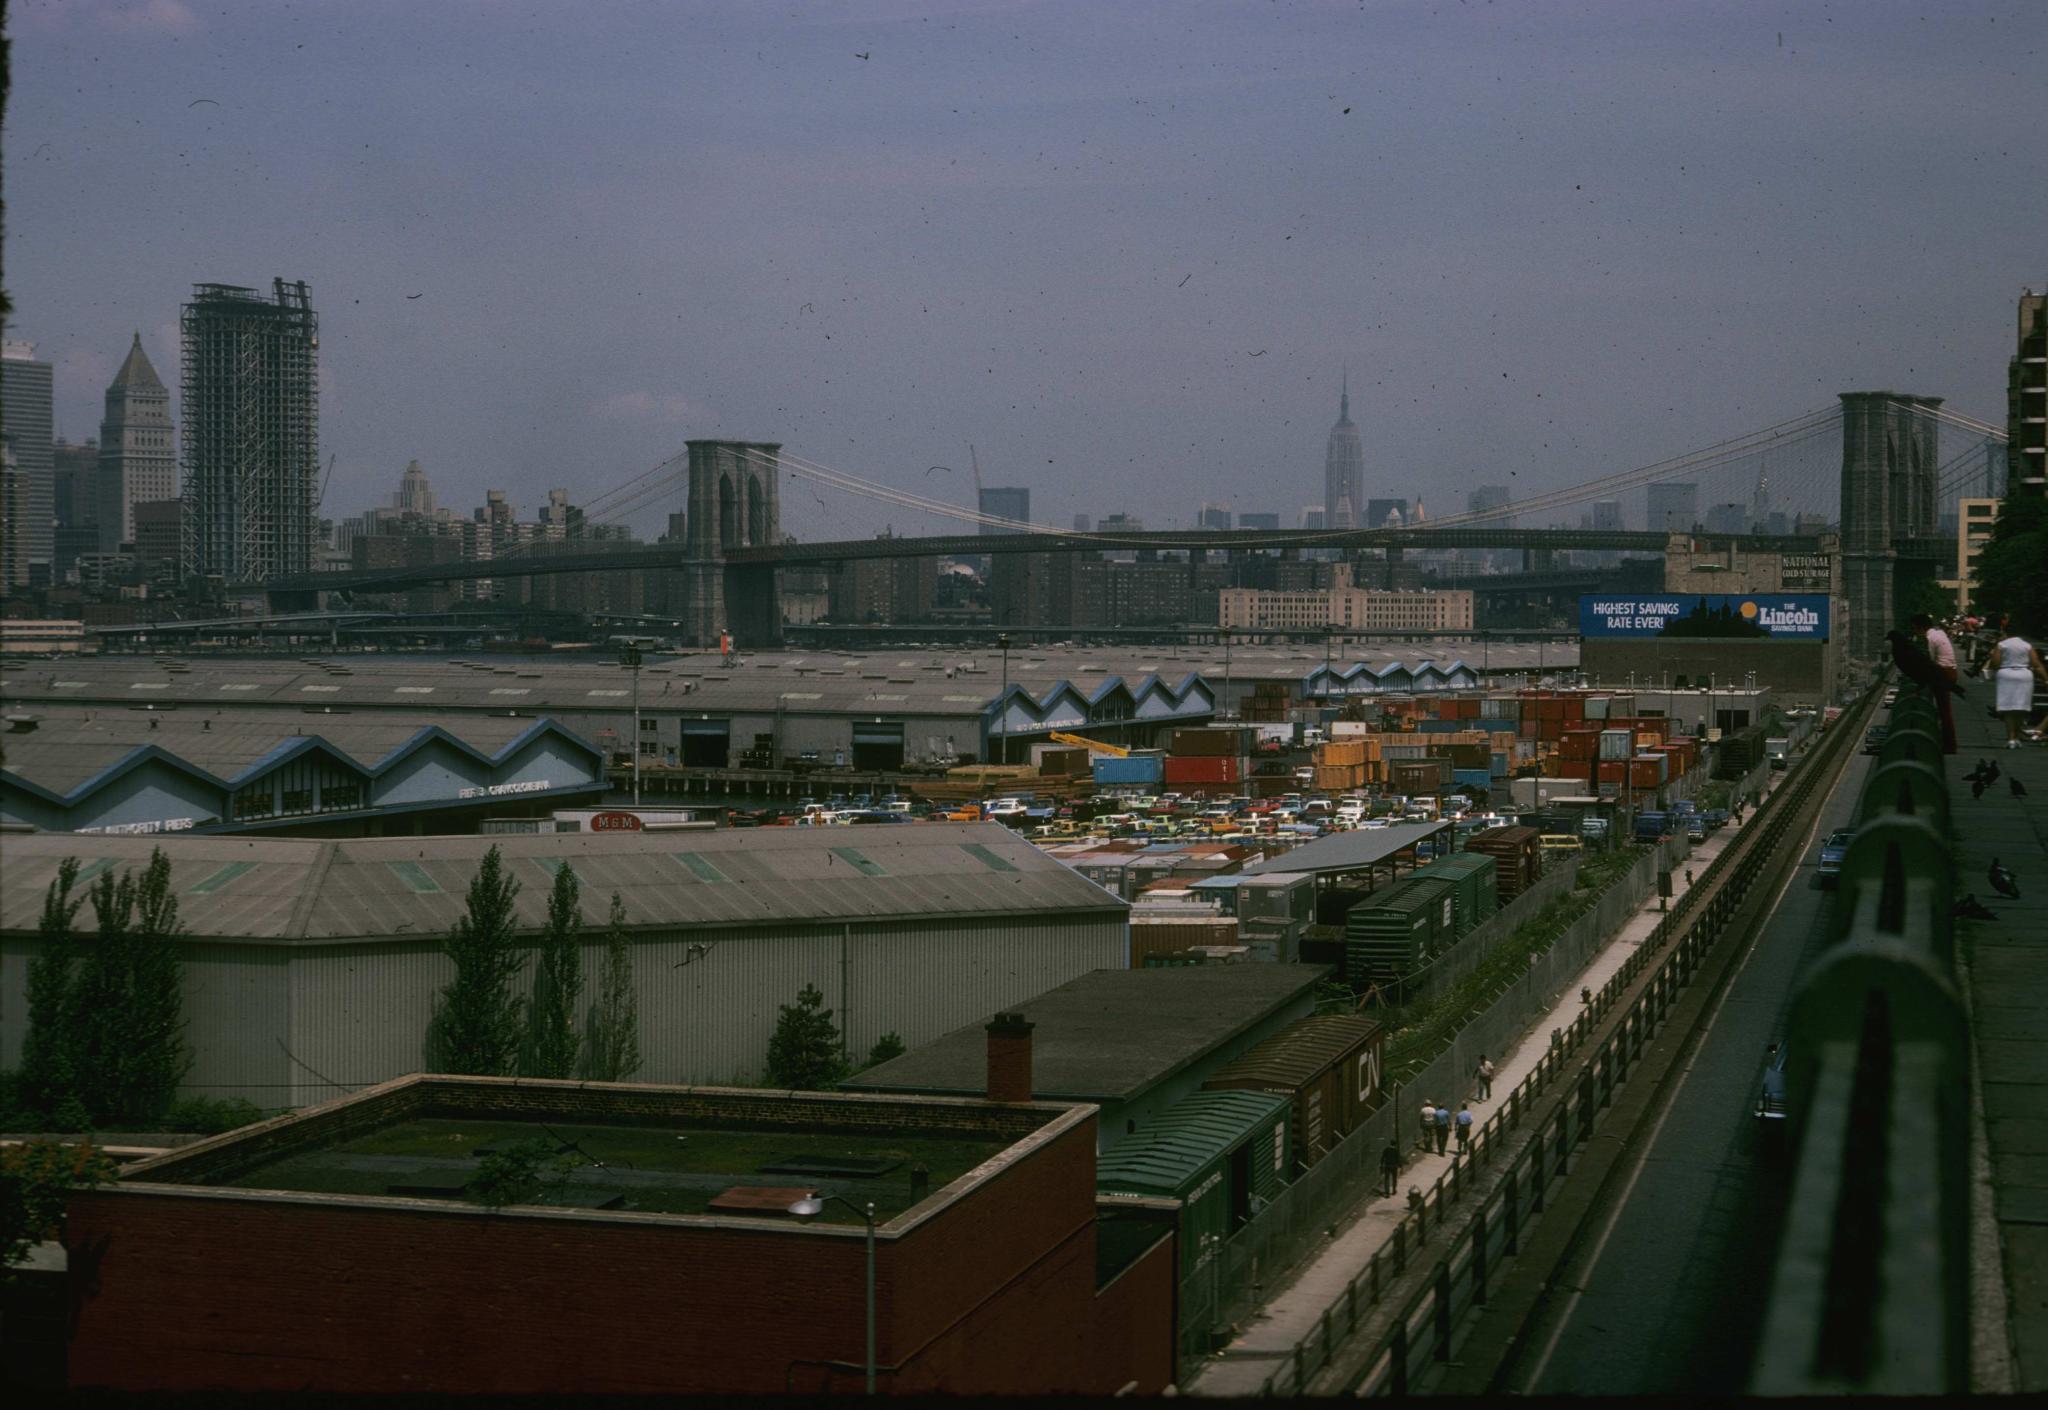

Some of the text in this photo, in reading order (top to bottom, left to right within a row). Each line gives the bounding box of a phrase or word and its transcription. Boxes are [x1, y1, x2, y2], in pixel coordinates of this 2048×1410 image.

[1783, 556, 1829, 567] NATIONAL
[1783, 569, 1799, 577] COLD
[1593, 603, 1679, 614] HIGHEST SAVINGS
[1759, 607, 1819, 625] Lincoln
[1607, 617, 1664, 628] RATE EVER!
[598, 816, 609, 828] M
[622, 816, 633, 828] M
[1359, 1042, 1380, 1102] CN
